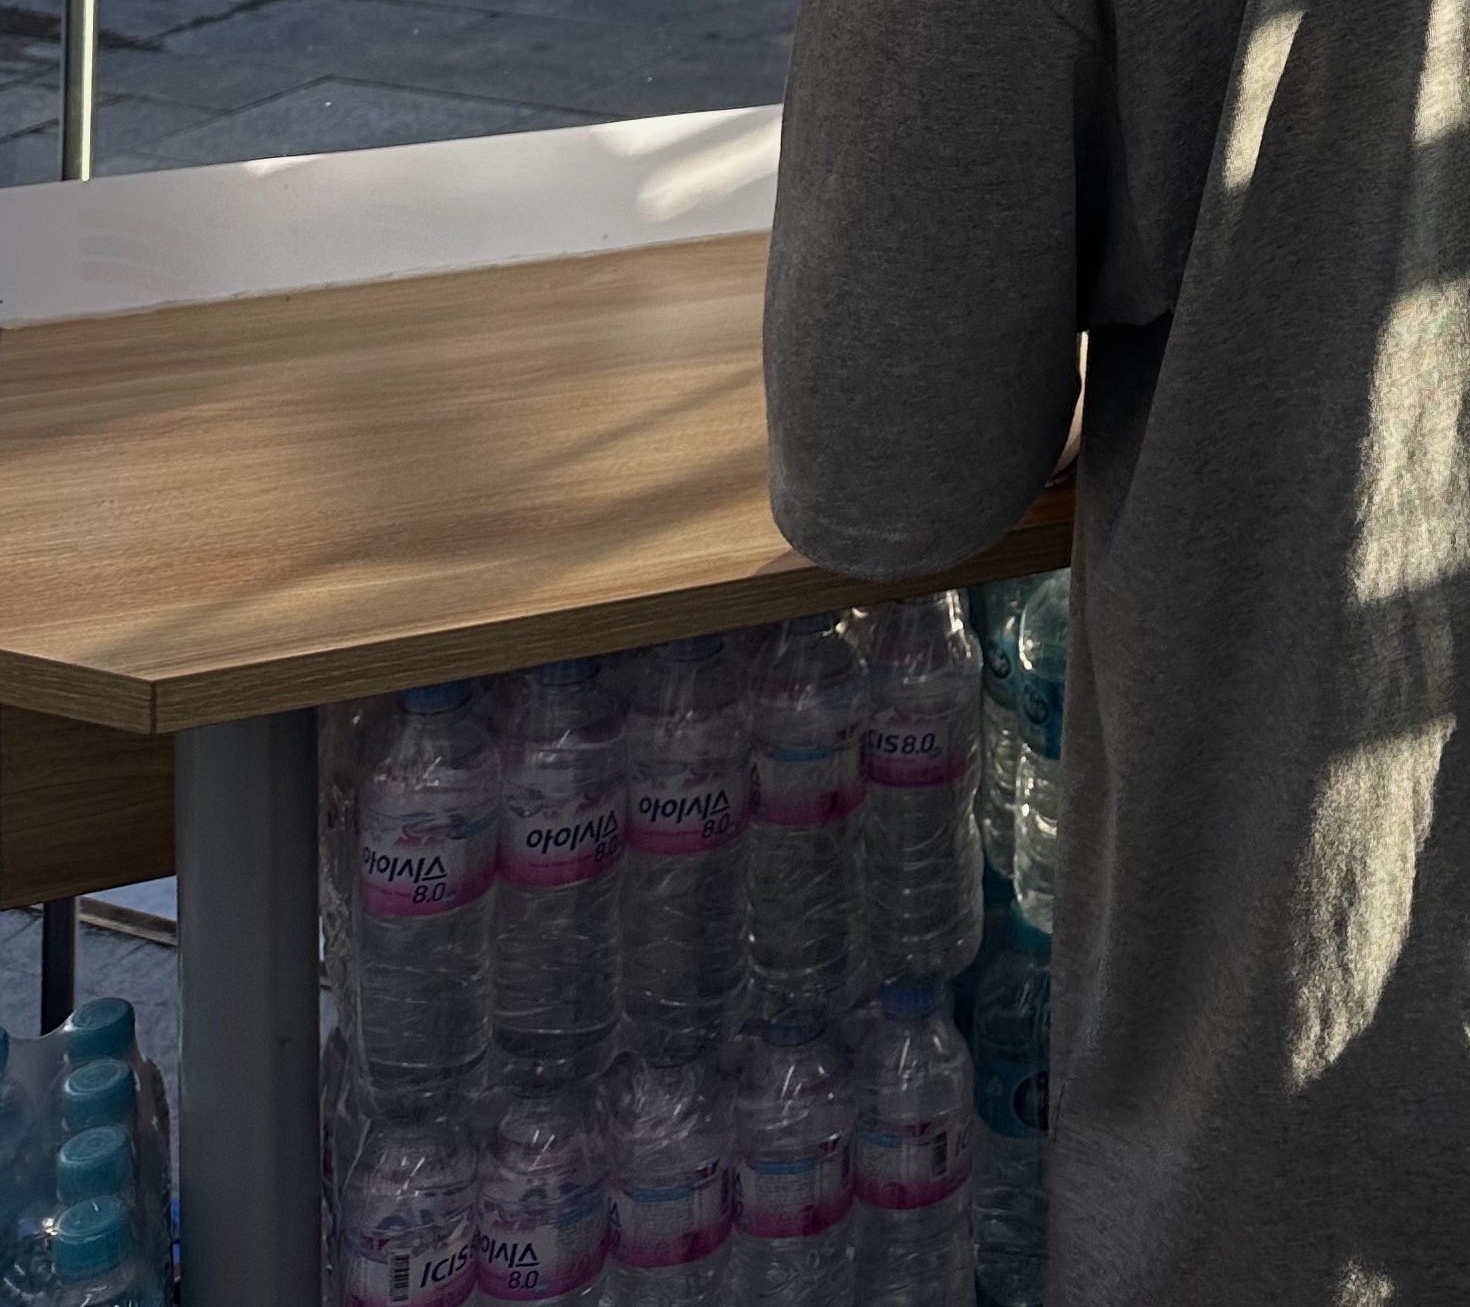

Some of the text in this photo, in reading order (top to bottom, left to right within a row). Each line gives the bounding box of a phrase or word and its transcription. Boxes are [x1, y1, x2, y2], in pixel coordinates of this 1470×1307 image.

[901, 732, 936, 754] 8.0
[639, 789, 731, 823] 아이시스
[525, 809, 619, 855] 아이시스
[362, 846, 448, 884] 아이시스
[412, 882, 447, 904] 8.0
[480, 1234, 540, 1269] 이시스
[508, 1270, 540, 1290] 8.0
